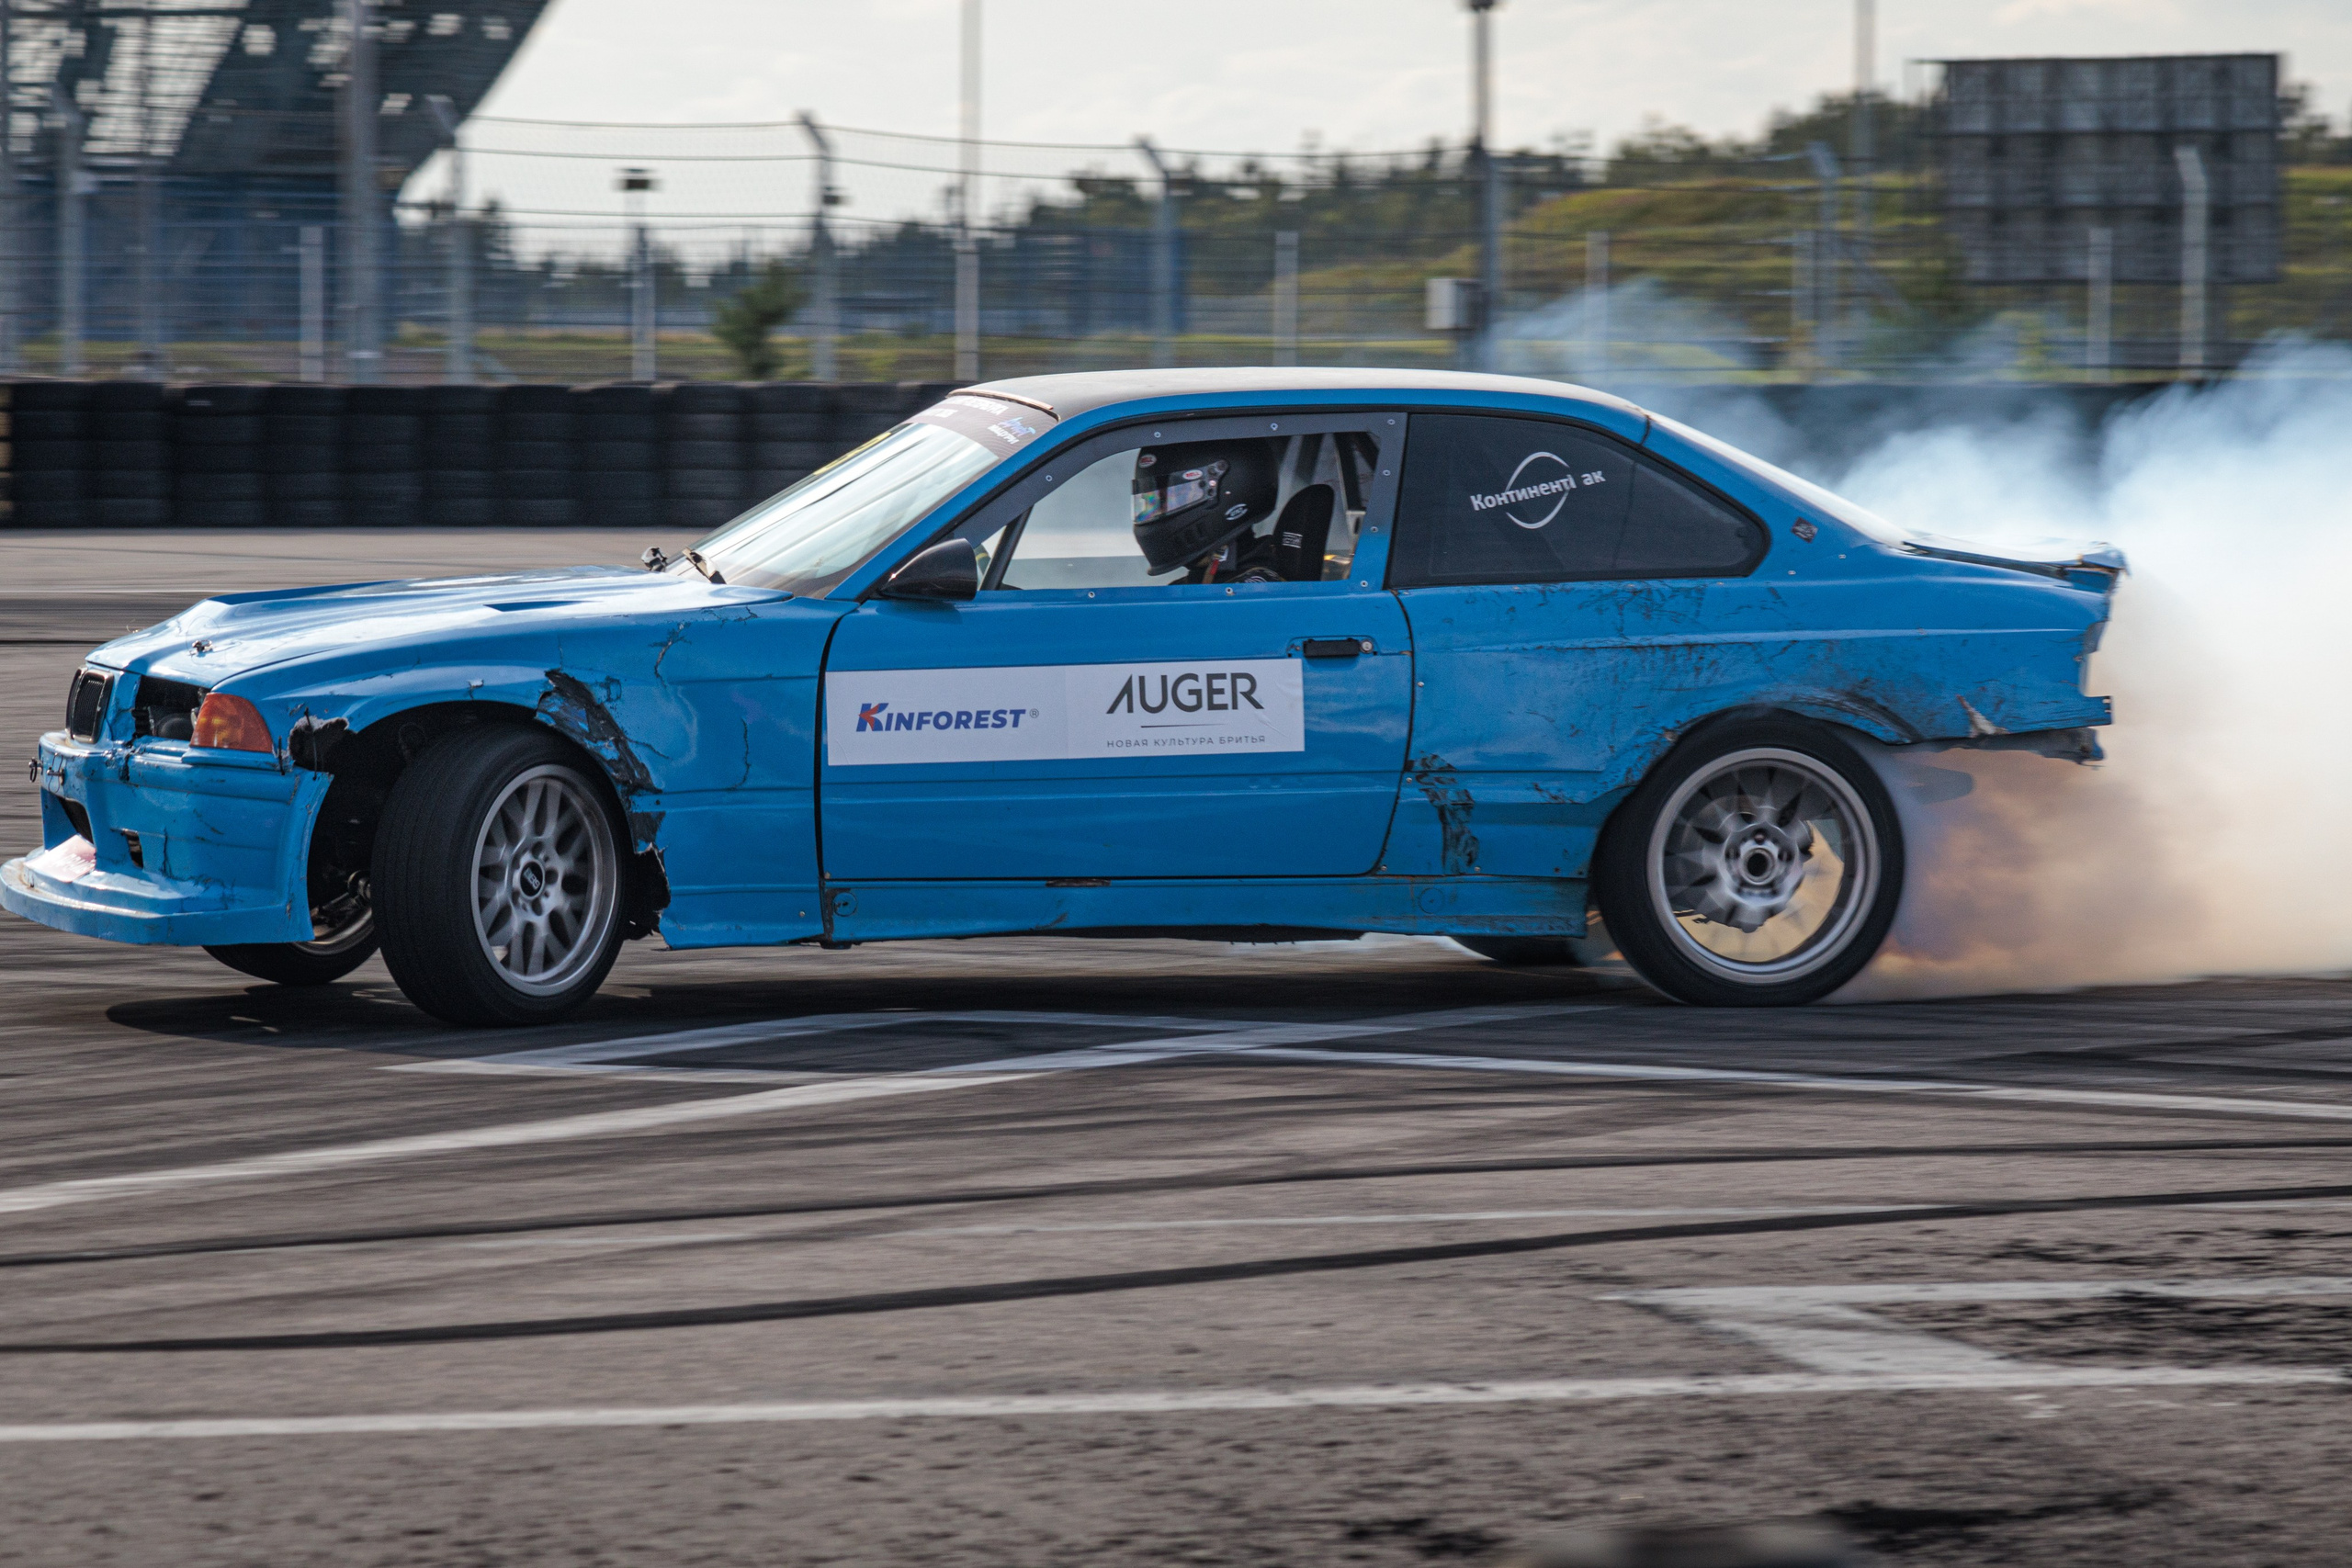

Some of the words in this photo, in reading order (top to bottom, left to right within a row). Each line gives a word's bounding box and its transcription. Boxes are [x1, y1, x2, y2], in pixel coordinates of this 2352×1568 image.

[1106, 672, 1265, 714] AUGER
[1106, 739, 1148, 749] НОВАЯ
[1153, 737, 1215, 747] КУЛЬТУРА
[1218, 735, 1266, 745] БРИТЬЯ
